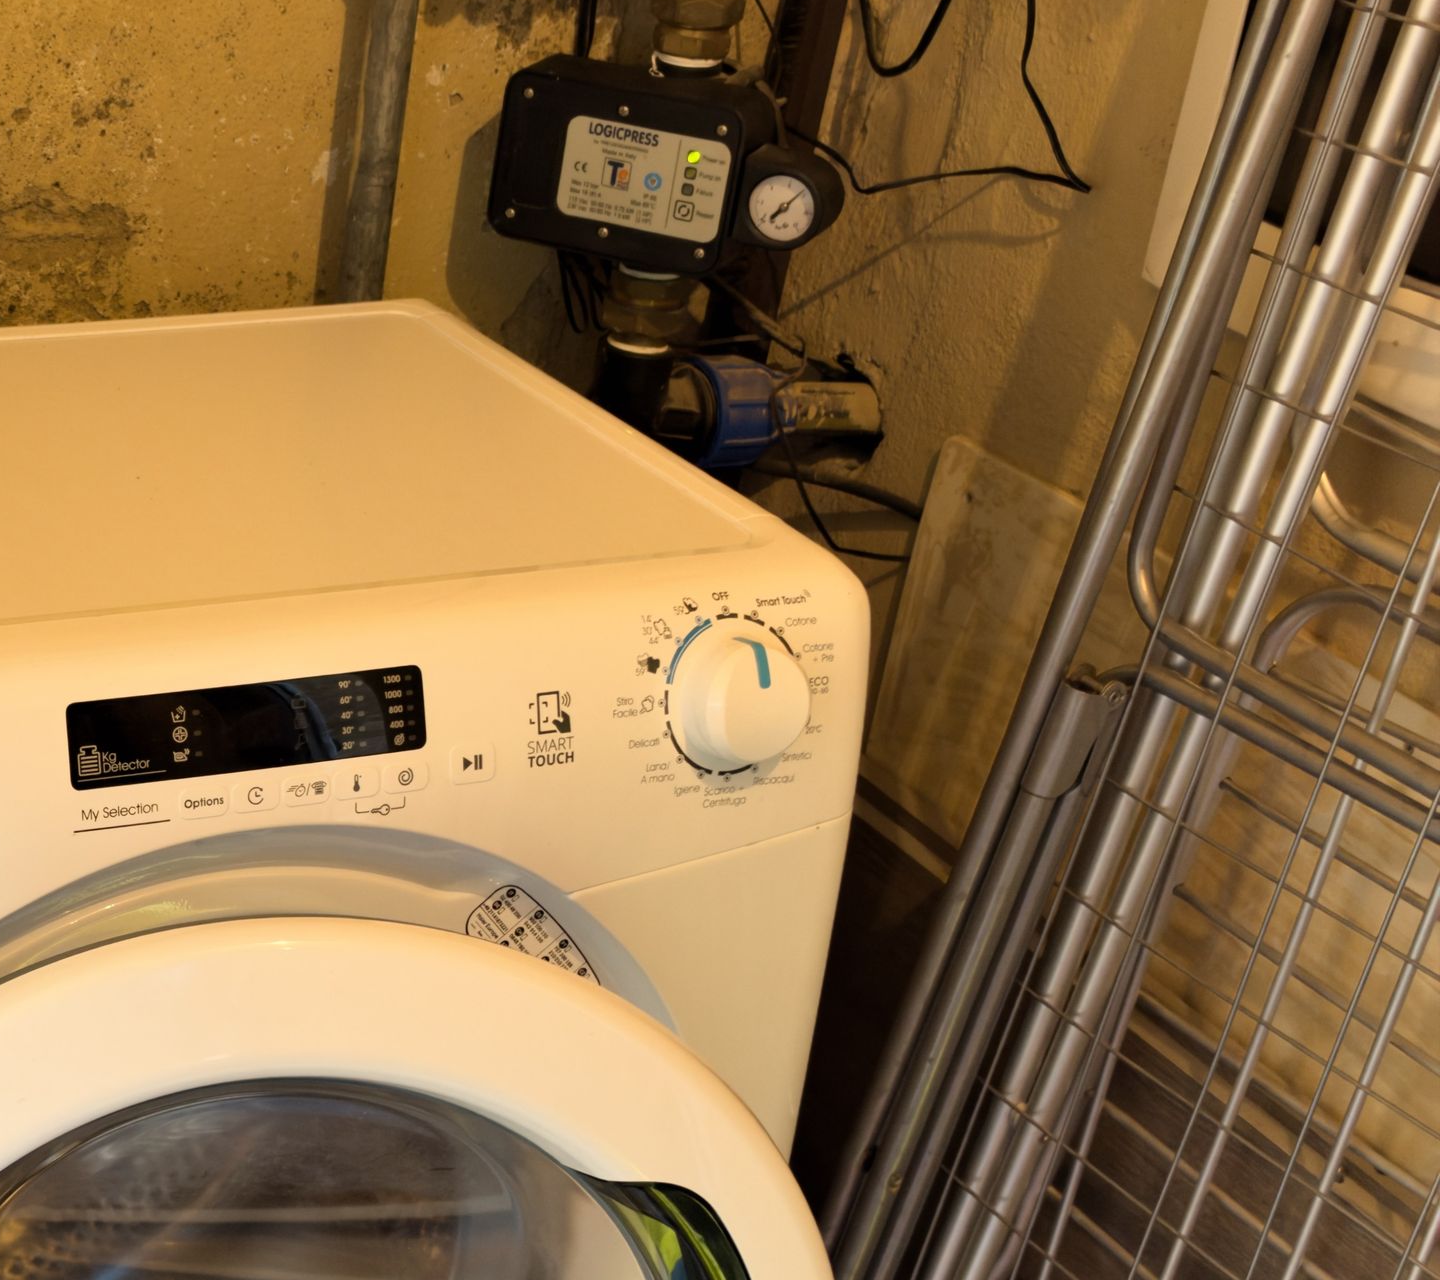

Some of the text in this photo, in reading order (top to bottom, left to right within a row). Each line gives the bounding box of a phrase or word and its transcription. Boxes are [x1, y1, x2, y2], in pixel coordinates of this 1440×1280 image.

[589, 122, 660, 147] LOGICPRESS
[712, 591, 729, 601] OFF
[756, 595, 806, 607] Smart Touch
[785, 617, 817, 627] Cotone
[802, 642, 834, 653] Cotone
[338, 680, 351, 689] 90°
[383, 675, 401, 684] 1300
[809, 676, 829, 687] ECO
[384, 690, 402, 699] 1000
[340, 696, 352, 705] 60°
[617, 697, 633, 707] Stiro
[341, 711, 354, 719] 40°
[388, 705, 403, 714] 800
[613, 709, 638, 718] Facile
[390, 720, 404, 729] 400
[342, 726, 354, 735] 30°
[342, 741, 355, 750] 20°
[527, 736, 575, 754] SMART
[628, 737, 660, 749] Delicati
[102, 751, 117, 764] Kg
[527, 751, 575, 768] TOUCH
[102, 758, 150, 774] Detector
[641, 773, 676, 784] A mano
[674, 783, 700, 797] Igiene
[704, 786, 735, 797] Scarico
[184, 796, 225, 810] Options
[702, 797, 747, 808] Centrifuga
[81, 802, 159, 822] My Selection
[485, 923, 498, 939] Europe
